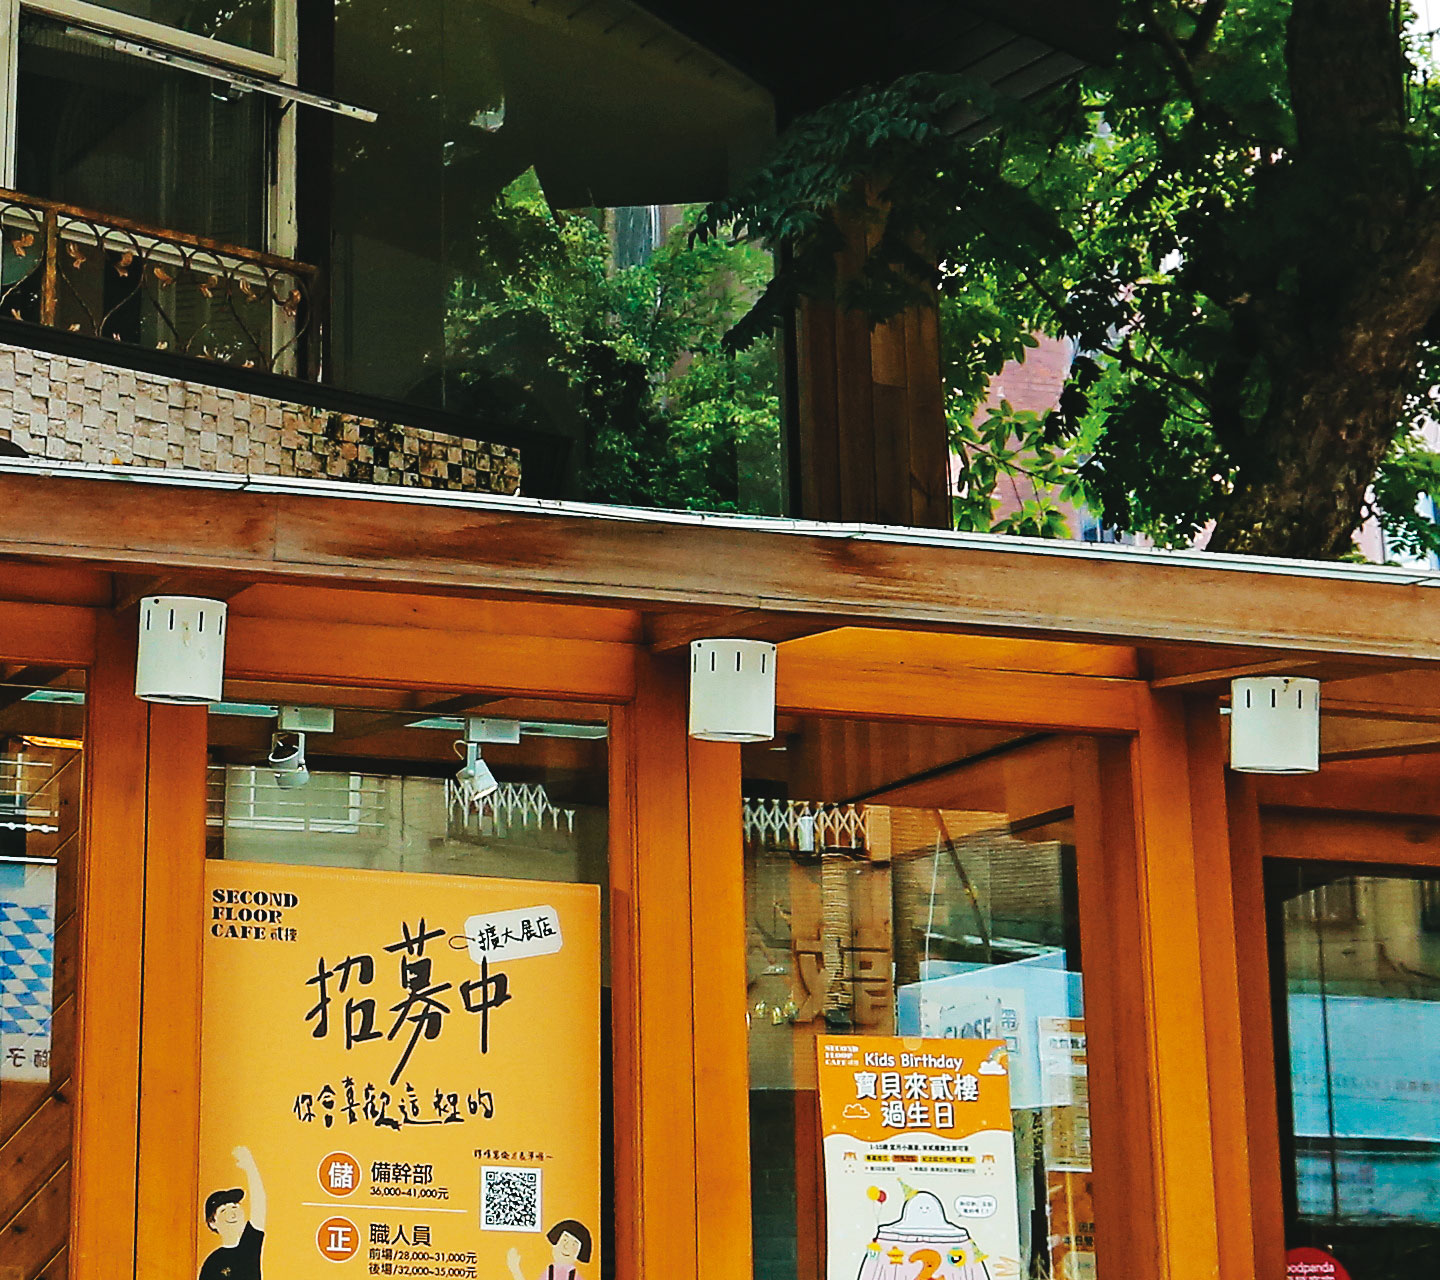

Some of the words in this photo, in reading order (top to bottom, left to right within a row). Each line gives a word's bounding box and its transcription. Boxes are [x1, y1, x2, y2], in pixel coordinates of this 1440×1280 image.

[212, 889, 299, 908] SECOND
[212, 906, 283, 924] FLOOR
[211, 923, 266, 941] CAFE
[478, 916, 557, 952] 擴大展店
[305, 917, 512, 1086] 招募中
[864, 1053, 896, 1068] Kids
[900, 1053, 963, 1073] Birthday
[853, 1071, 979, 1102] 寶貝來貳樓
[293, 1076, 495, 1131] 你會喜歡這裡的
[880, 1101, 955, 1129] 過生日
[328, 1161, 354, 1189] 儲
[371, 1161, 434, 1186] 備幹部
[326, 1226, 352, 1253] 正
[369, 1223, 432, 1247] 職人員
